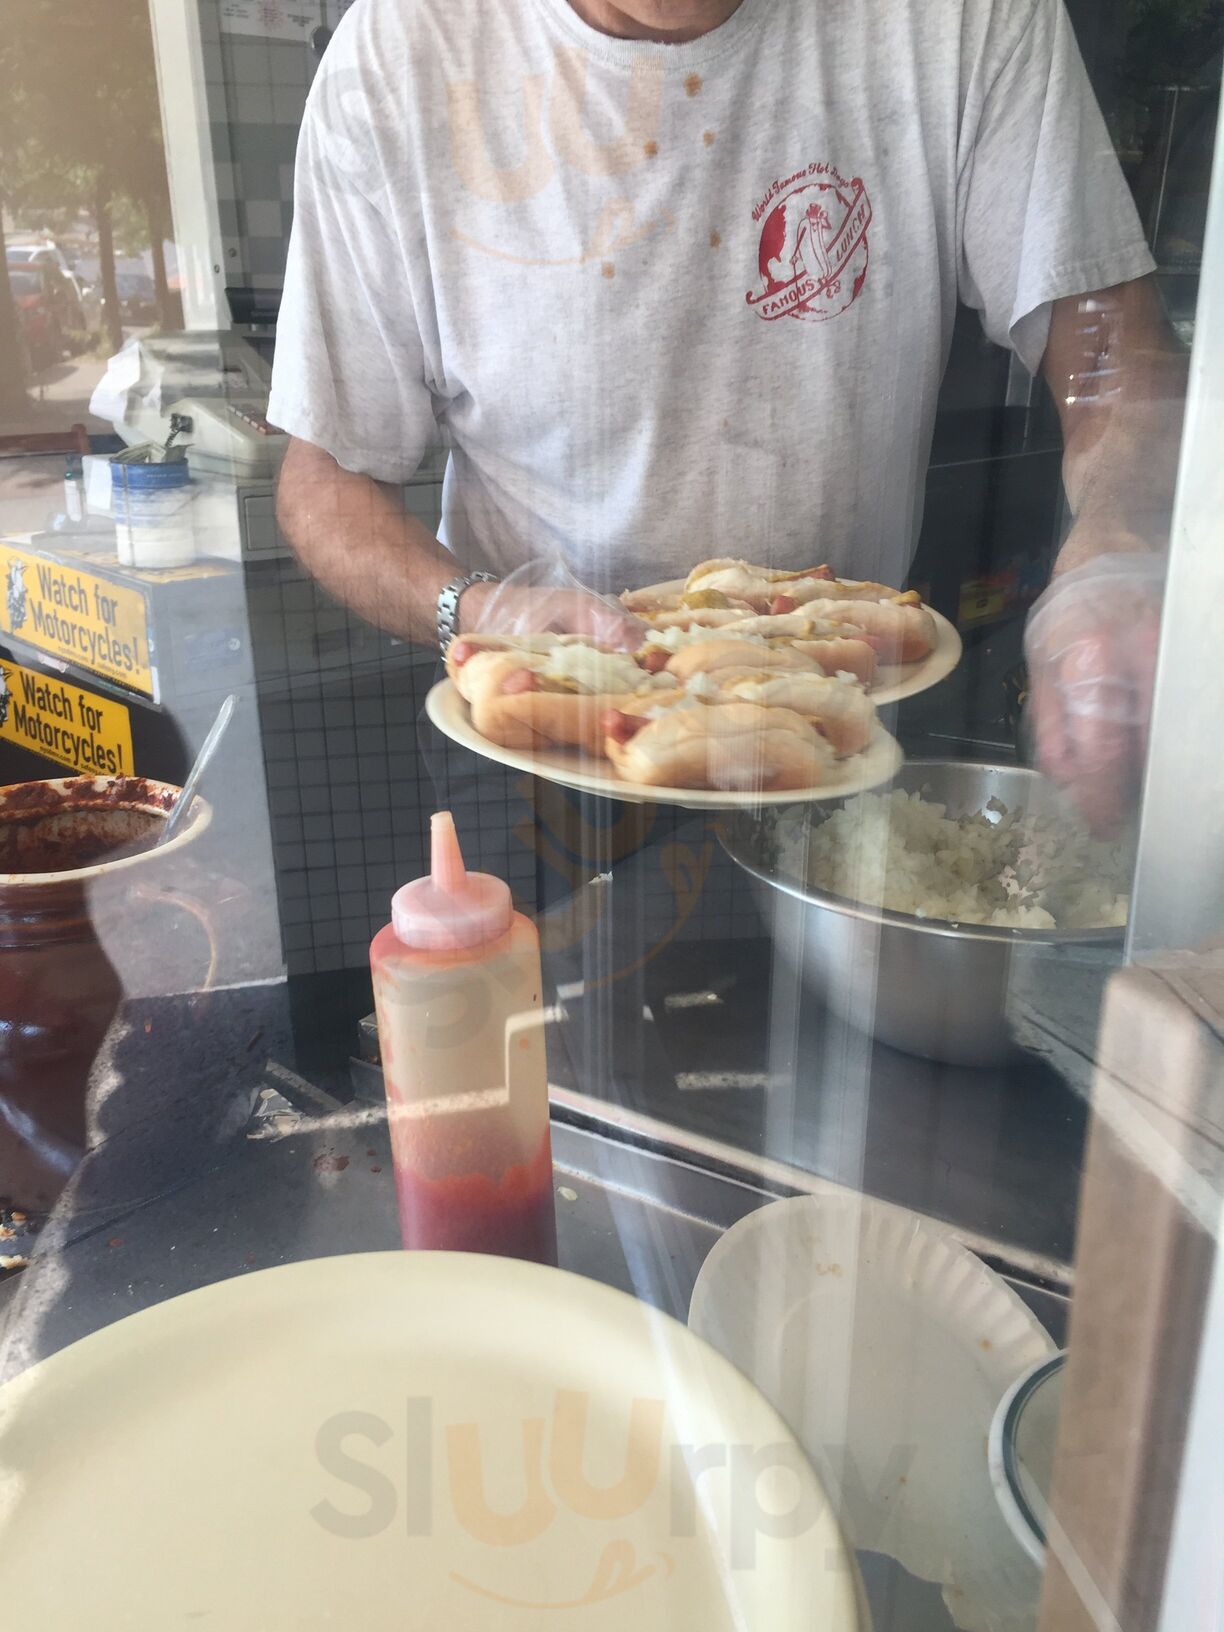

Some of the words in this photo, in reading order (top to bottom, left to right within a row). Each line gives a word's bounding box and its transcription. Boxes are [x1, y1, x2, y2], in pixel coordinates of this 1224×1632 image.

[751, 189, 774, 222] World
[772, 169, 807, 193] Famous
[808, 162, 829, 175] Hot
[762, 278, 815, 315] FAMOUS
[836, 203, 866, 262] LUNCH
[36, 563, 89, 617] Watch
[94, 584, 118, 628] for
[29, 598, 140, 675] Motorcycles!
[20, 671, 73, 723] Watch
[78, 694, 103, 734] for
[13, 701, 123, 774] Motorcycles!
